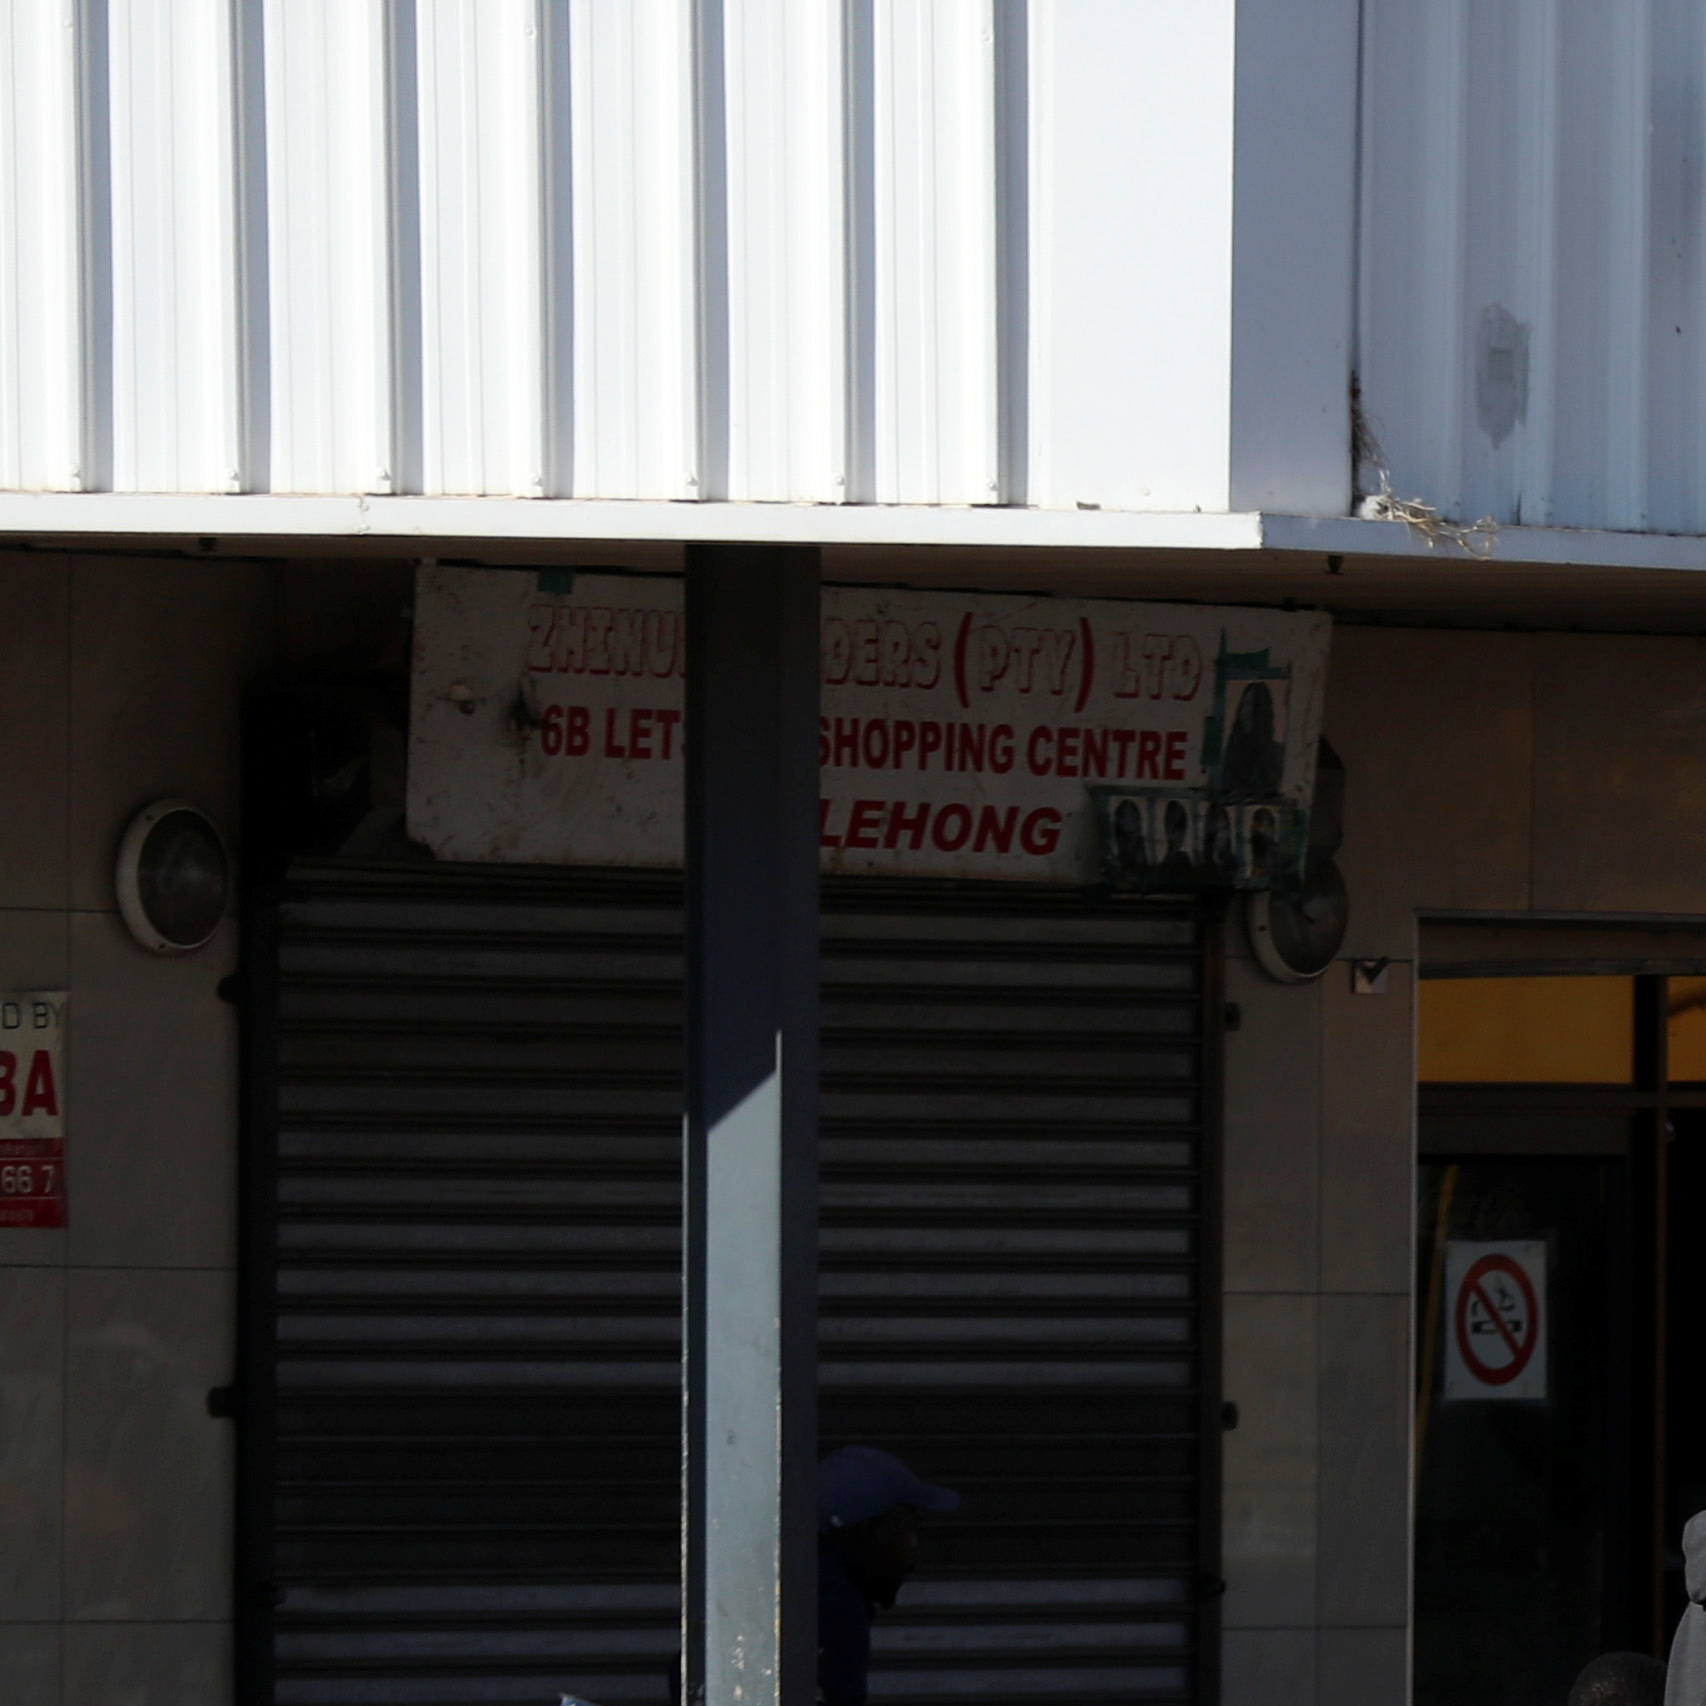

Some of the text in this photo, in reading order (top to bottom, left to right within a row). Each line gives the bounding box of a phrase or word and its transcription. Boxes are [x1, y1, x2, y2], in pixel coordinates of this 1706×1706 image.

[527, 604, 686, 678] ZHINU
[953, 611, 1094, 714] (PTY)
[1112, 631, 1203, 701] LTD
[540, 704, 591, 757] 6B
[1027, 726, 1189, 780] CENTRE
[820, 798, 1063, 857] LEHONG
